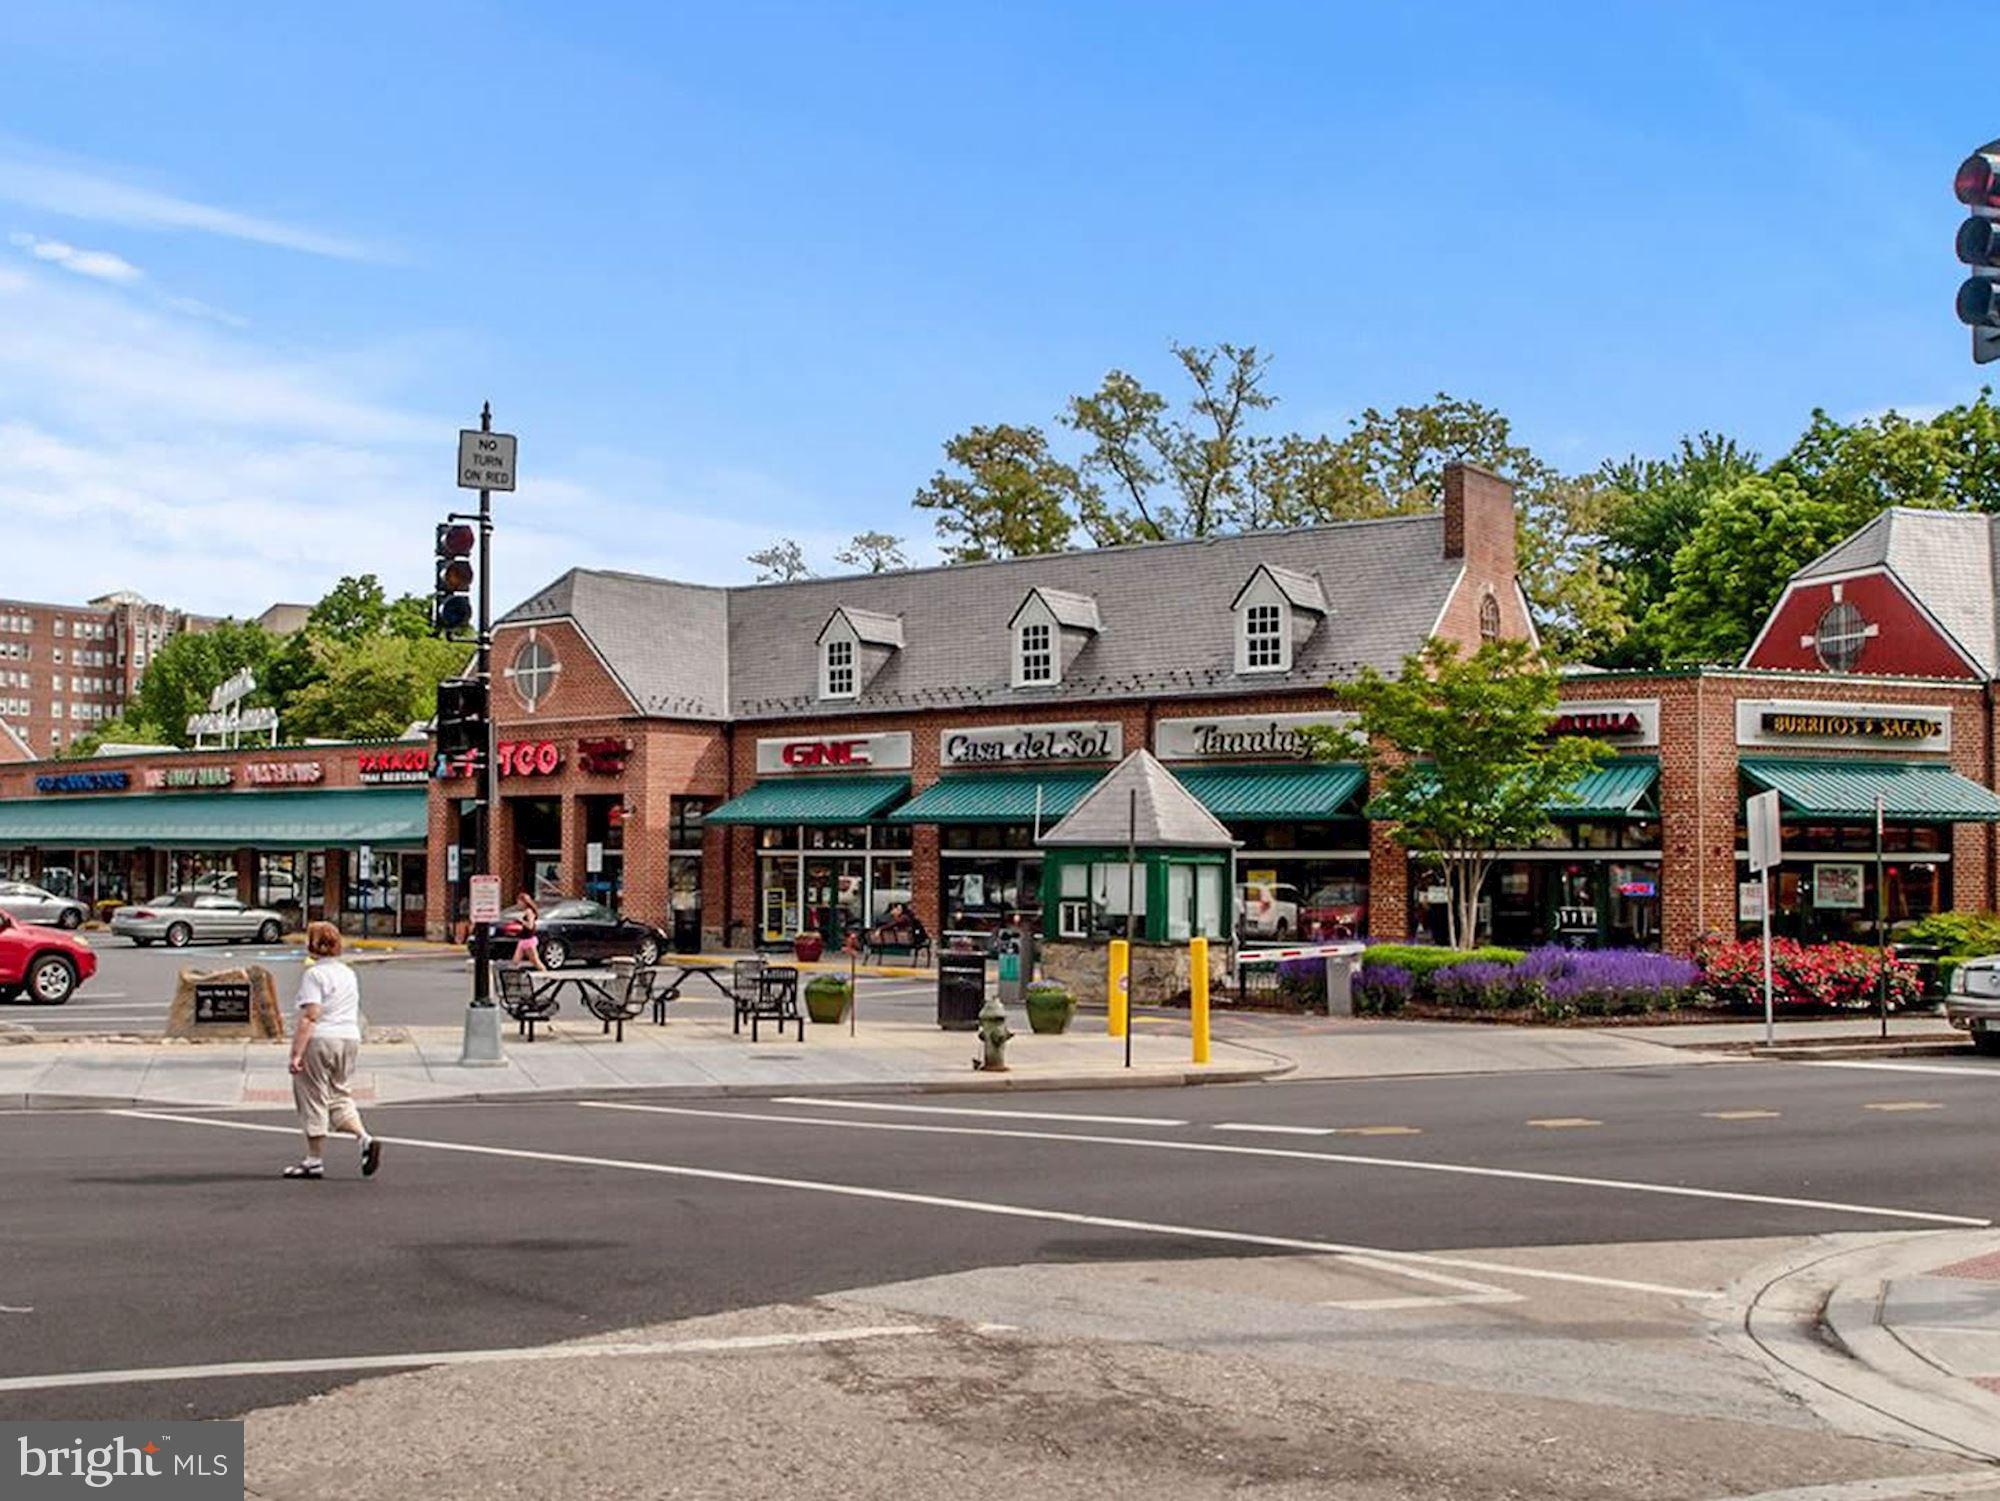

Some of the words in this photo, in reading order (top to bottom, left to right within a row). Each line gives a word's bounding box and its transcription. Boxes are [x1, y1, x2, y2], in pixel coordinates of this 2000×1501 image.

[478, 439, 497, 452] NO
[473, 454, 503, 467] TURN
[464, 468, 481, 481] ON
[485, 470, 509, 485] RED
[1774, 716, 1859, 734] BURRITOS
[948, 735, 1004, 763] Casa
[1015, 732, 1056, 760] del
[1062, 730, 1111, 760] Sol
[1193, 721, 1315, 759] Tanning
[783, 739, 869, 766] GNC
